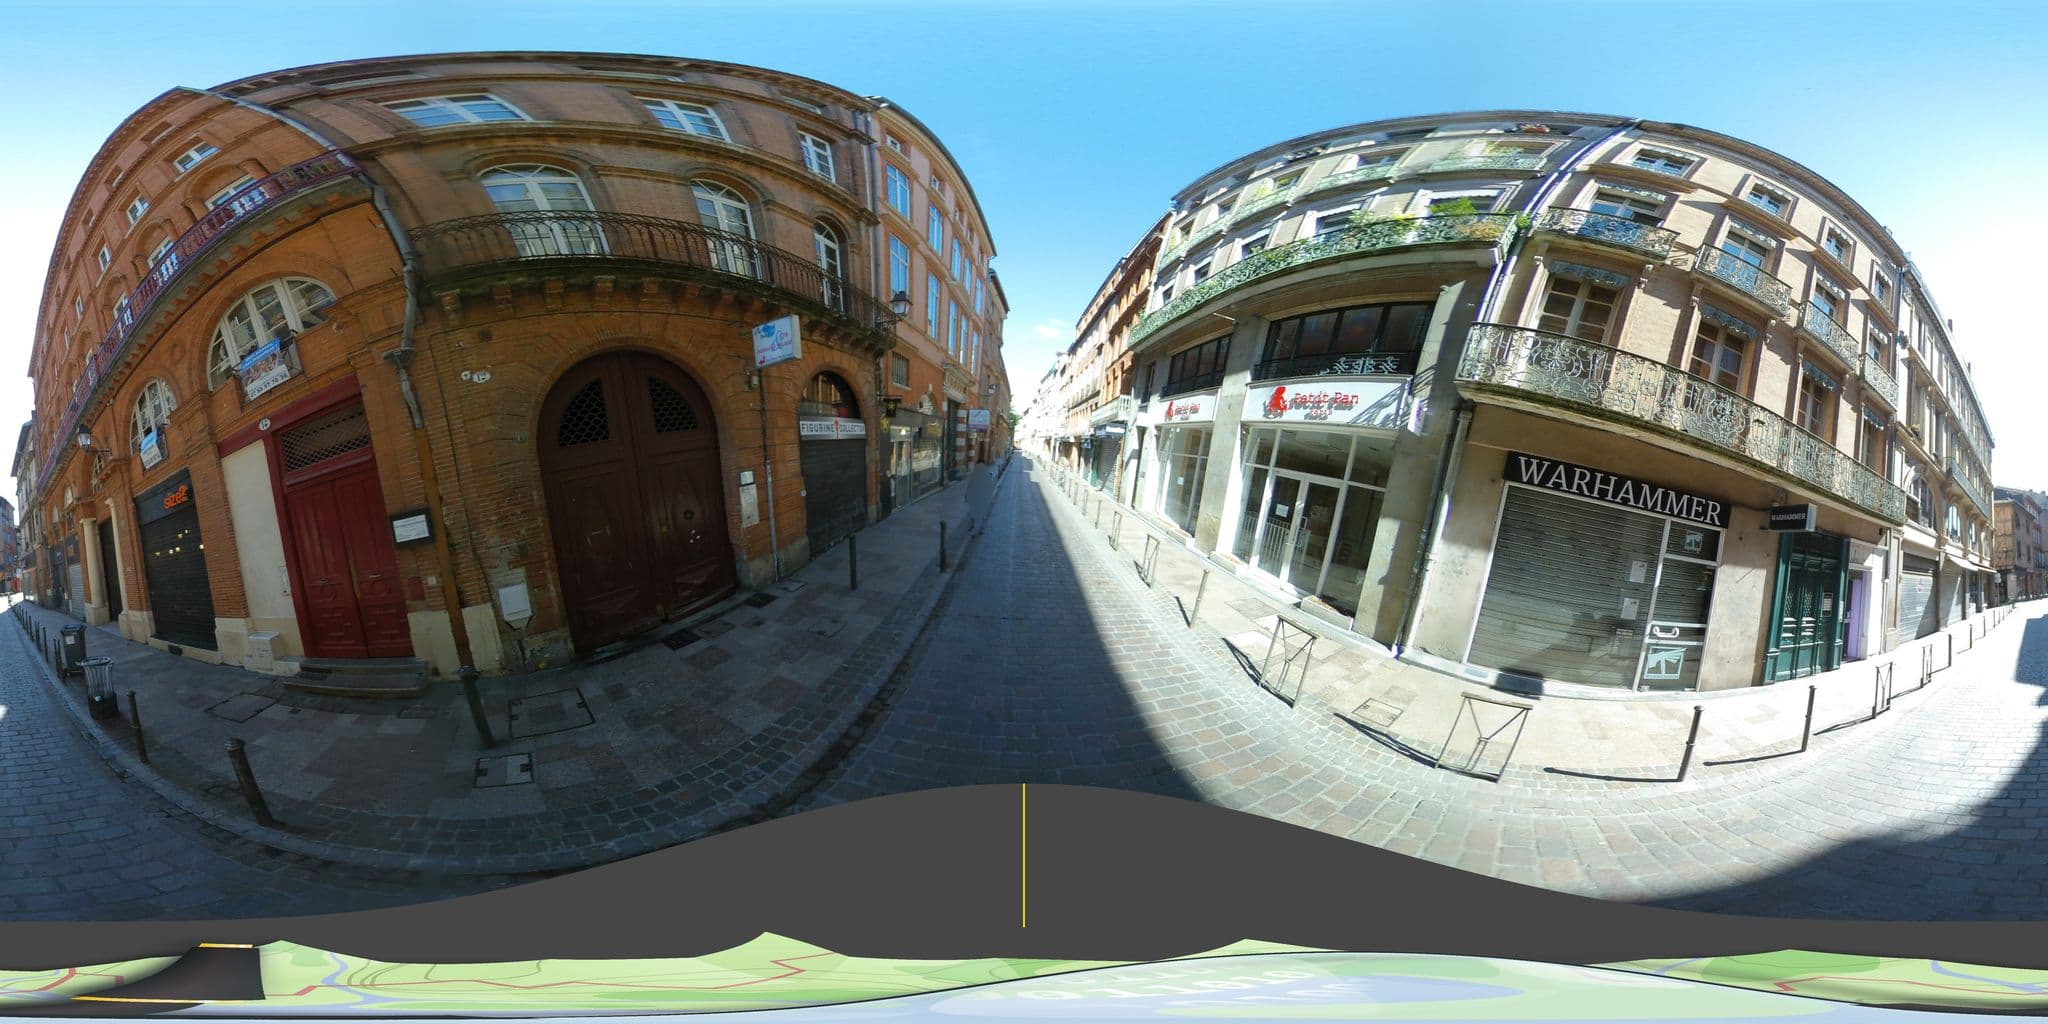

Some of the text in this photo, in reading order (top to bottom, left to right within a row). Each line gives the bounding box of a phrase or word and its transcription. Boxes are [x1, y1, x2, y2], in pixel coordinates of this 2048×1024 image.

[1333, 392, 1359, 404] Pan
[801, 423, 835, 433] FIGURINE
[1518, 455, 1721, 526] WARHAMMER
